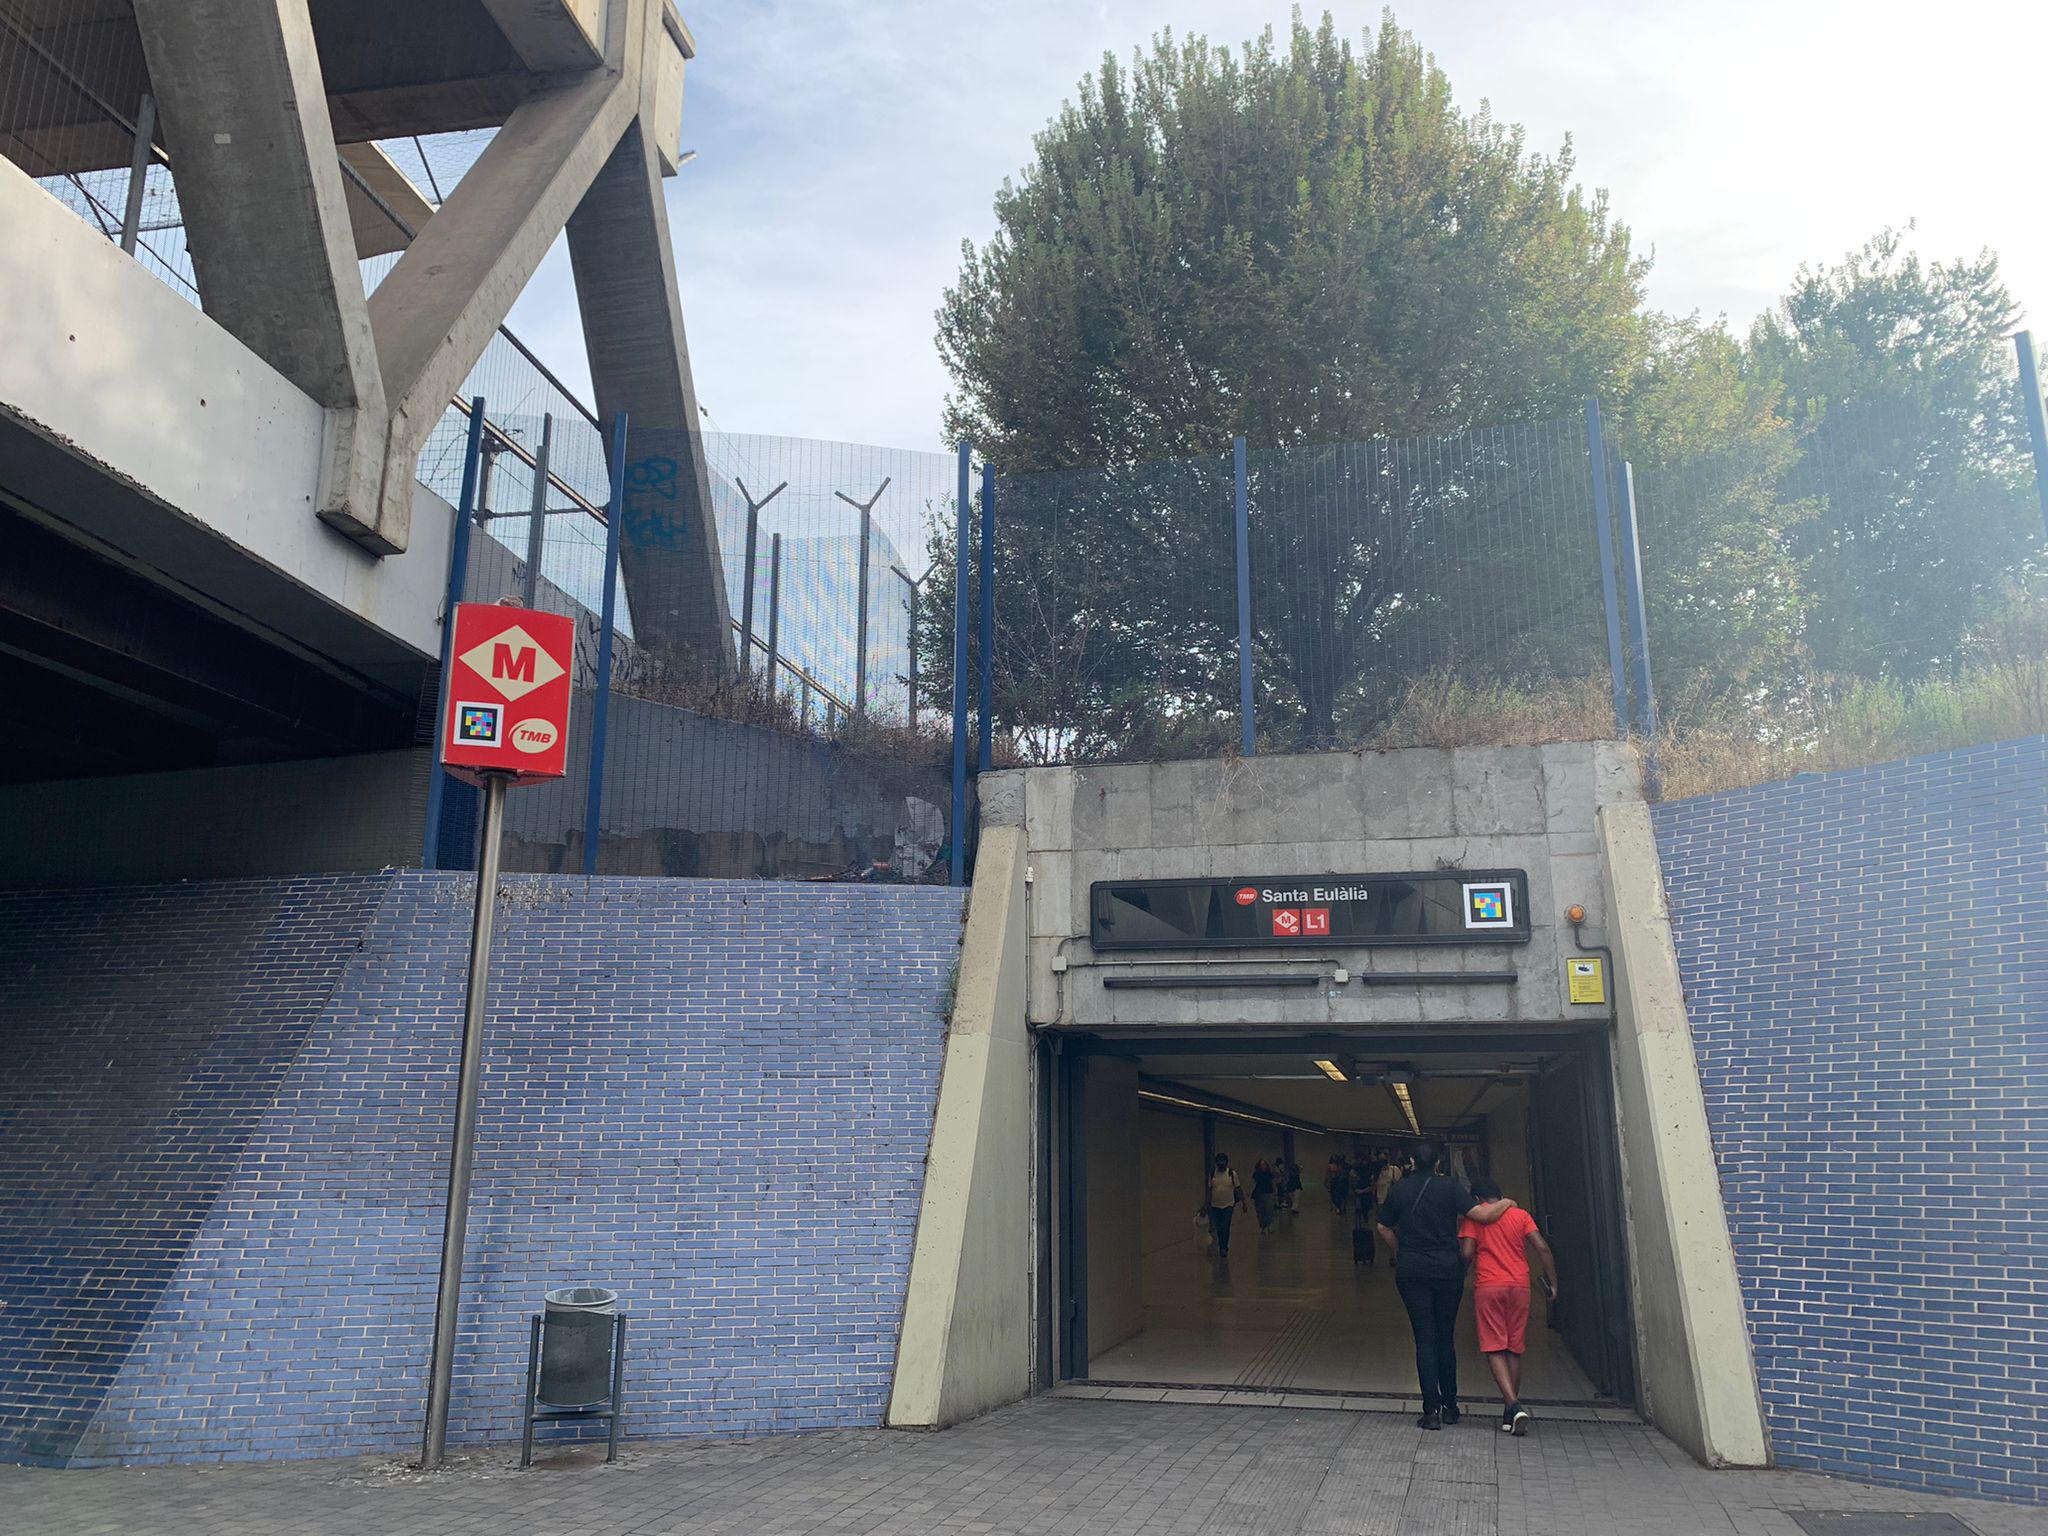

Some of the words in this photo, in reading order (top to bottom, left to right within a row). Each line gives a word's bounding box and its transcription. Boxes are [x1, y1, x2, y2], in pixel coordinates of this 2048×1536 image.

[491, 642, 537, 683] M
[520, 729, 552, 744] TMB
[1262, 889, 1309, 903] Santa
[1281, 915, 1291, 924] M
[1306, 913, 1325, 929] L1
